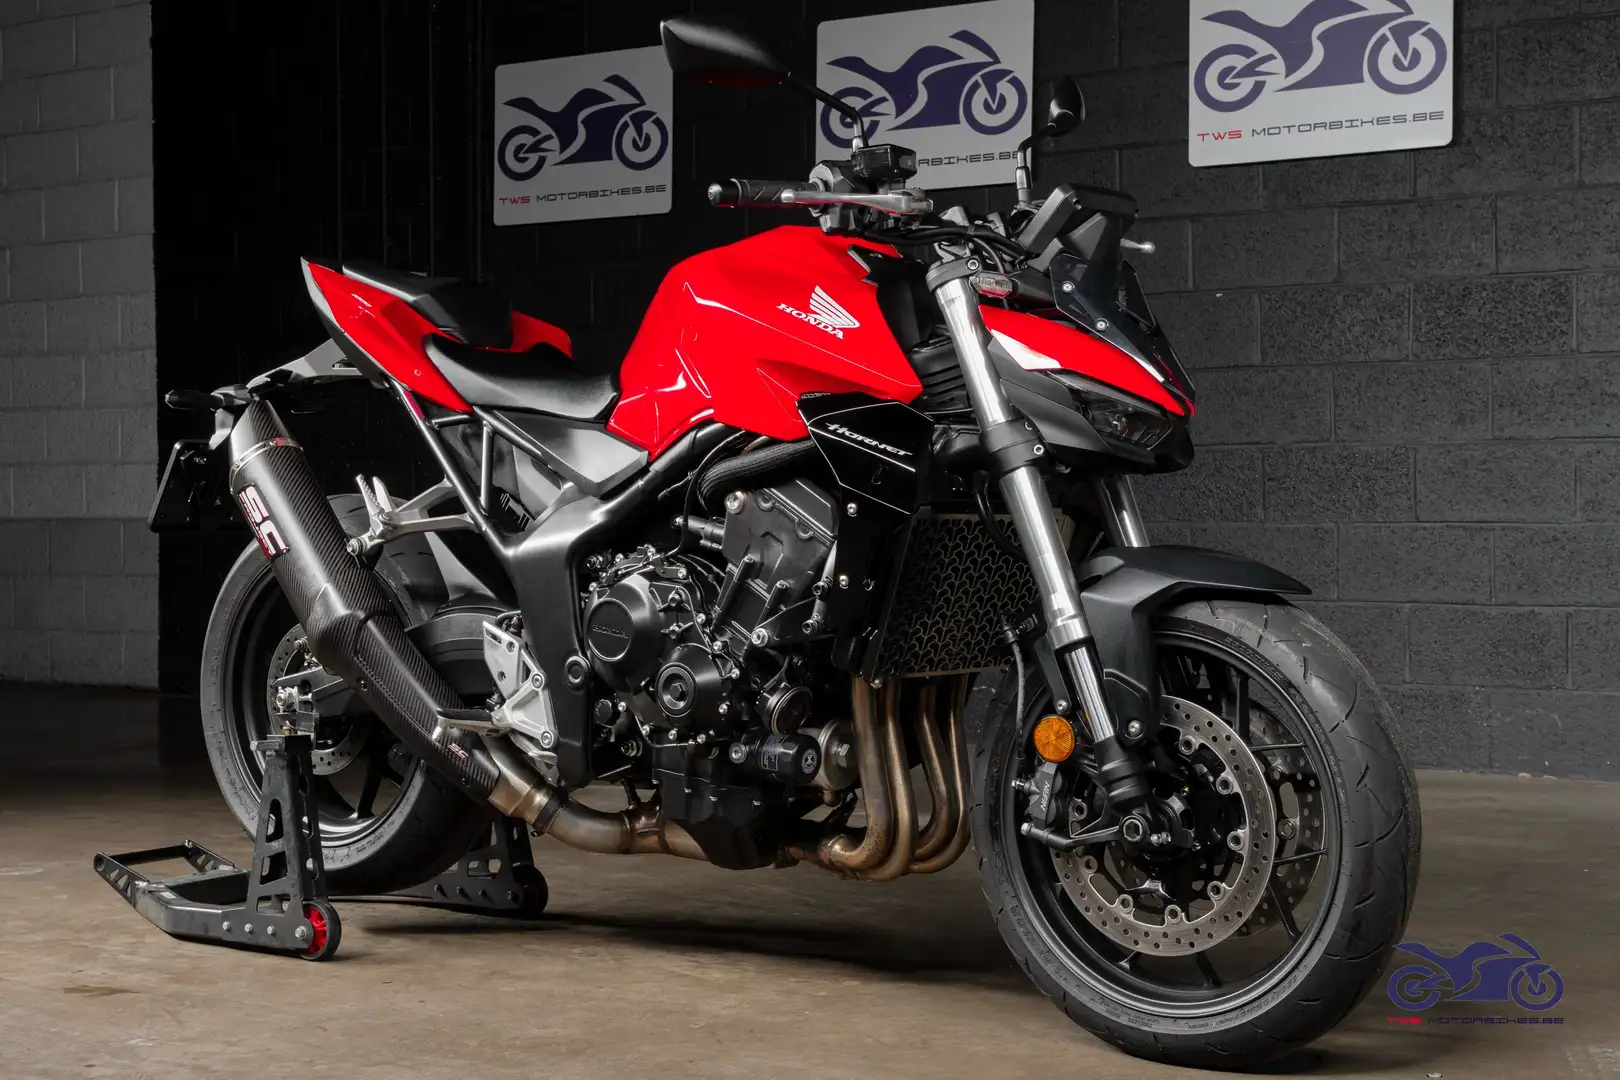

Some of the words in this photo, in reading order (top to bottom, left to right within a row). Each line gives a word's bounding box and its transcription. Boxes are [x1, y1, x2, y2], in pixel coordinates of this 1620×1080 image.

[1197, 129, 1243, 142] TWS
[1251, 110, 1445, 138] MOTORBIKES.BE
[918, 151, 1019, 168] RBIKES.BE
[499, 195, 531, 205] TWS
[536, 184, 667, 203] MOTORBIKES.BE
[776, 303, 844, 340] HONDA
